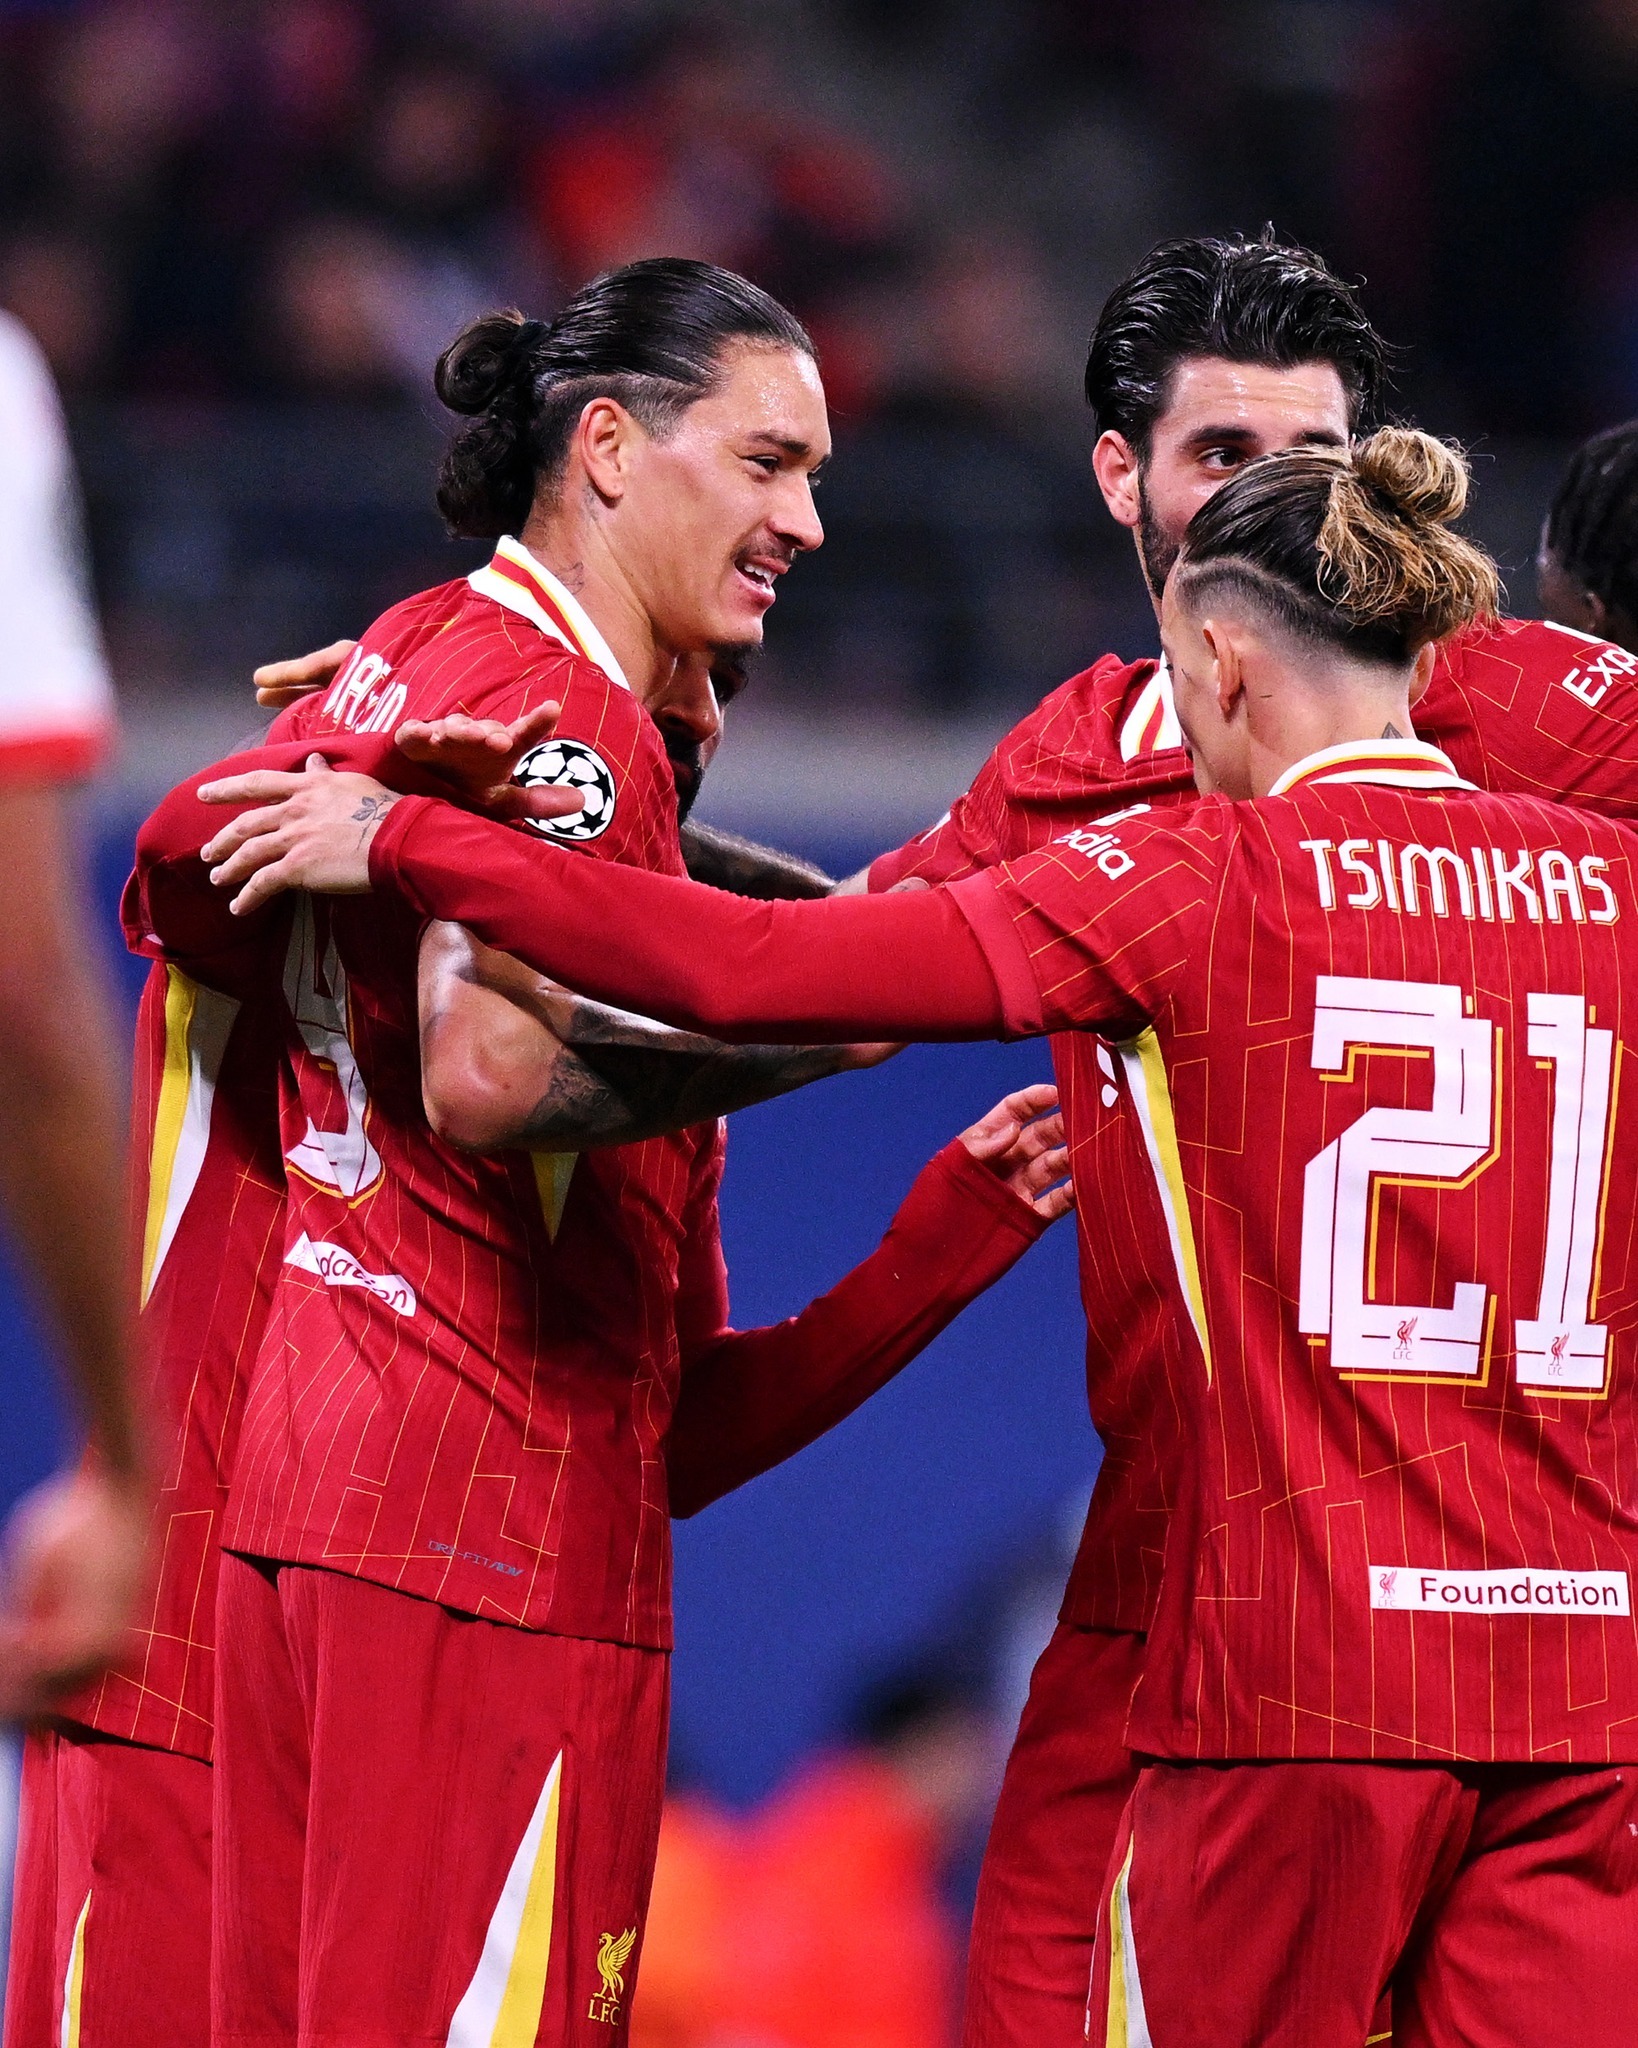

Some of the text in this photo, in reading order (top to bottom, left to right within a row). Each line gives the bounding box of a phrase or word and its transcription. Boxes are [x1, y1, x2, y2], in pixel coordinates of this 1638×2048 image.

[1562, 646, 1638, 707] Exp
[1299, 839, 1621, 926] TSIMIKAS
[1298, 975, 1623, 1400] 21
[1420, 1576, 1619, 1607] Foundation
